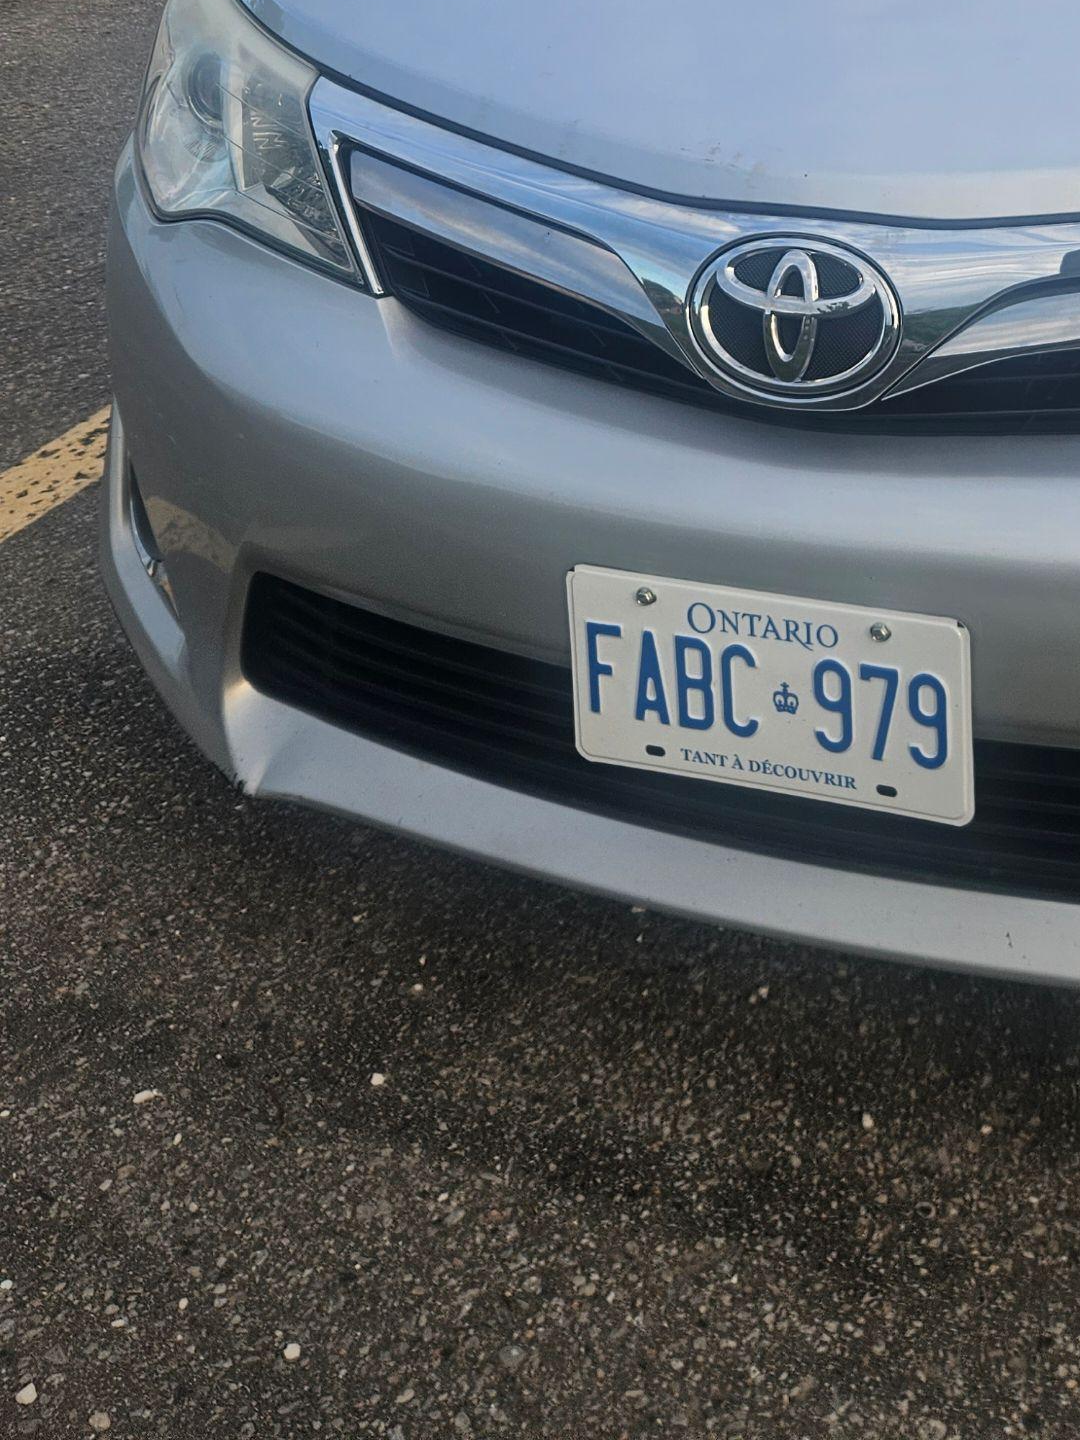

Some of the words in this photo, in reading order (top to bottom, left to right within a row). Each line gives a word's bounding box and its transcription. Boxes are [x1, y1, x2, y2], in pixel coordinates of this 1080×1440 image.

[585, 621, 759, 738] FABC
[813, 658, 948, 769] 979
[680, 747, 728, 767] TANT
[731, 754, 744, 771] À
[749, 759, 857, 790] DÉCOUVRIR
